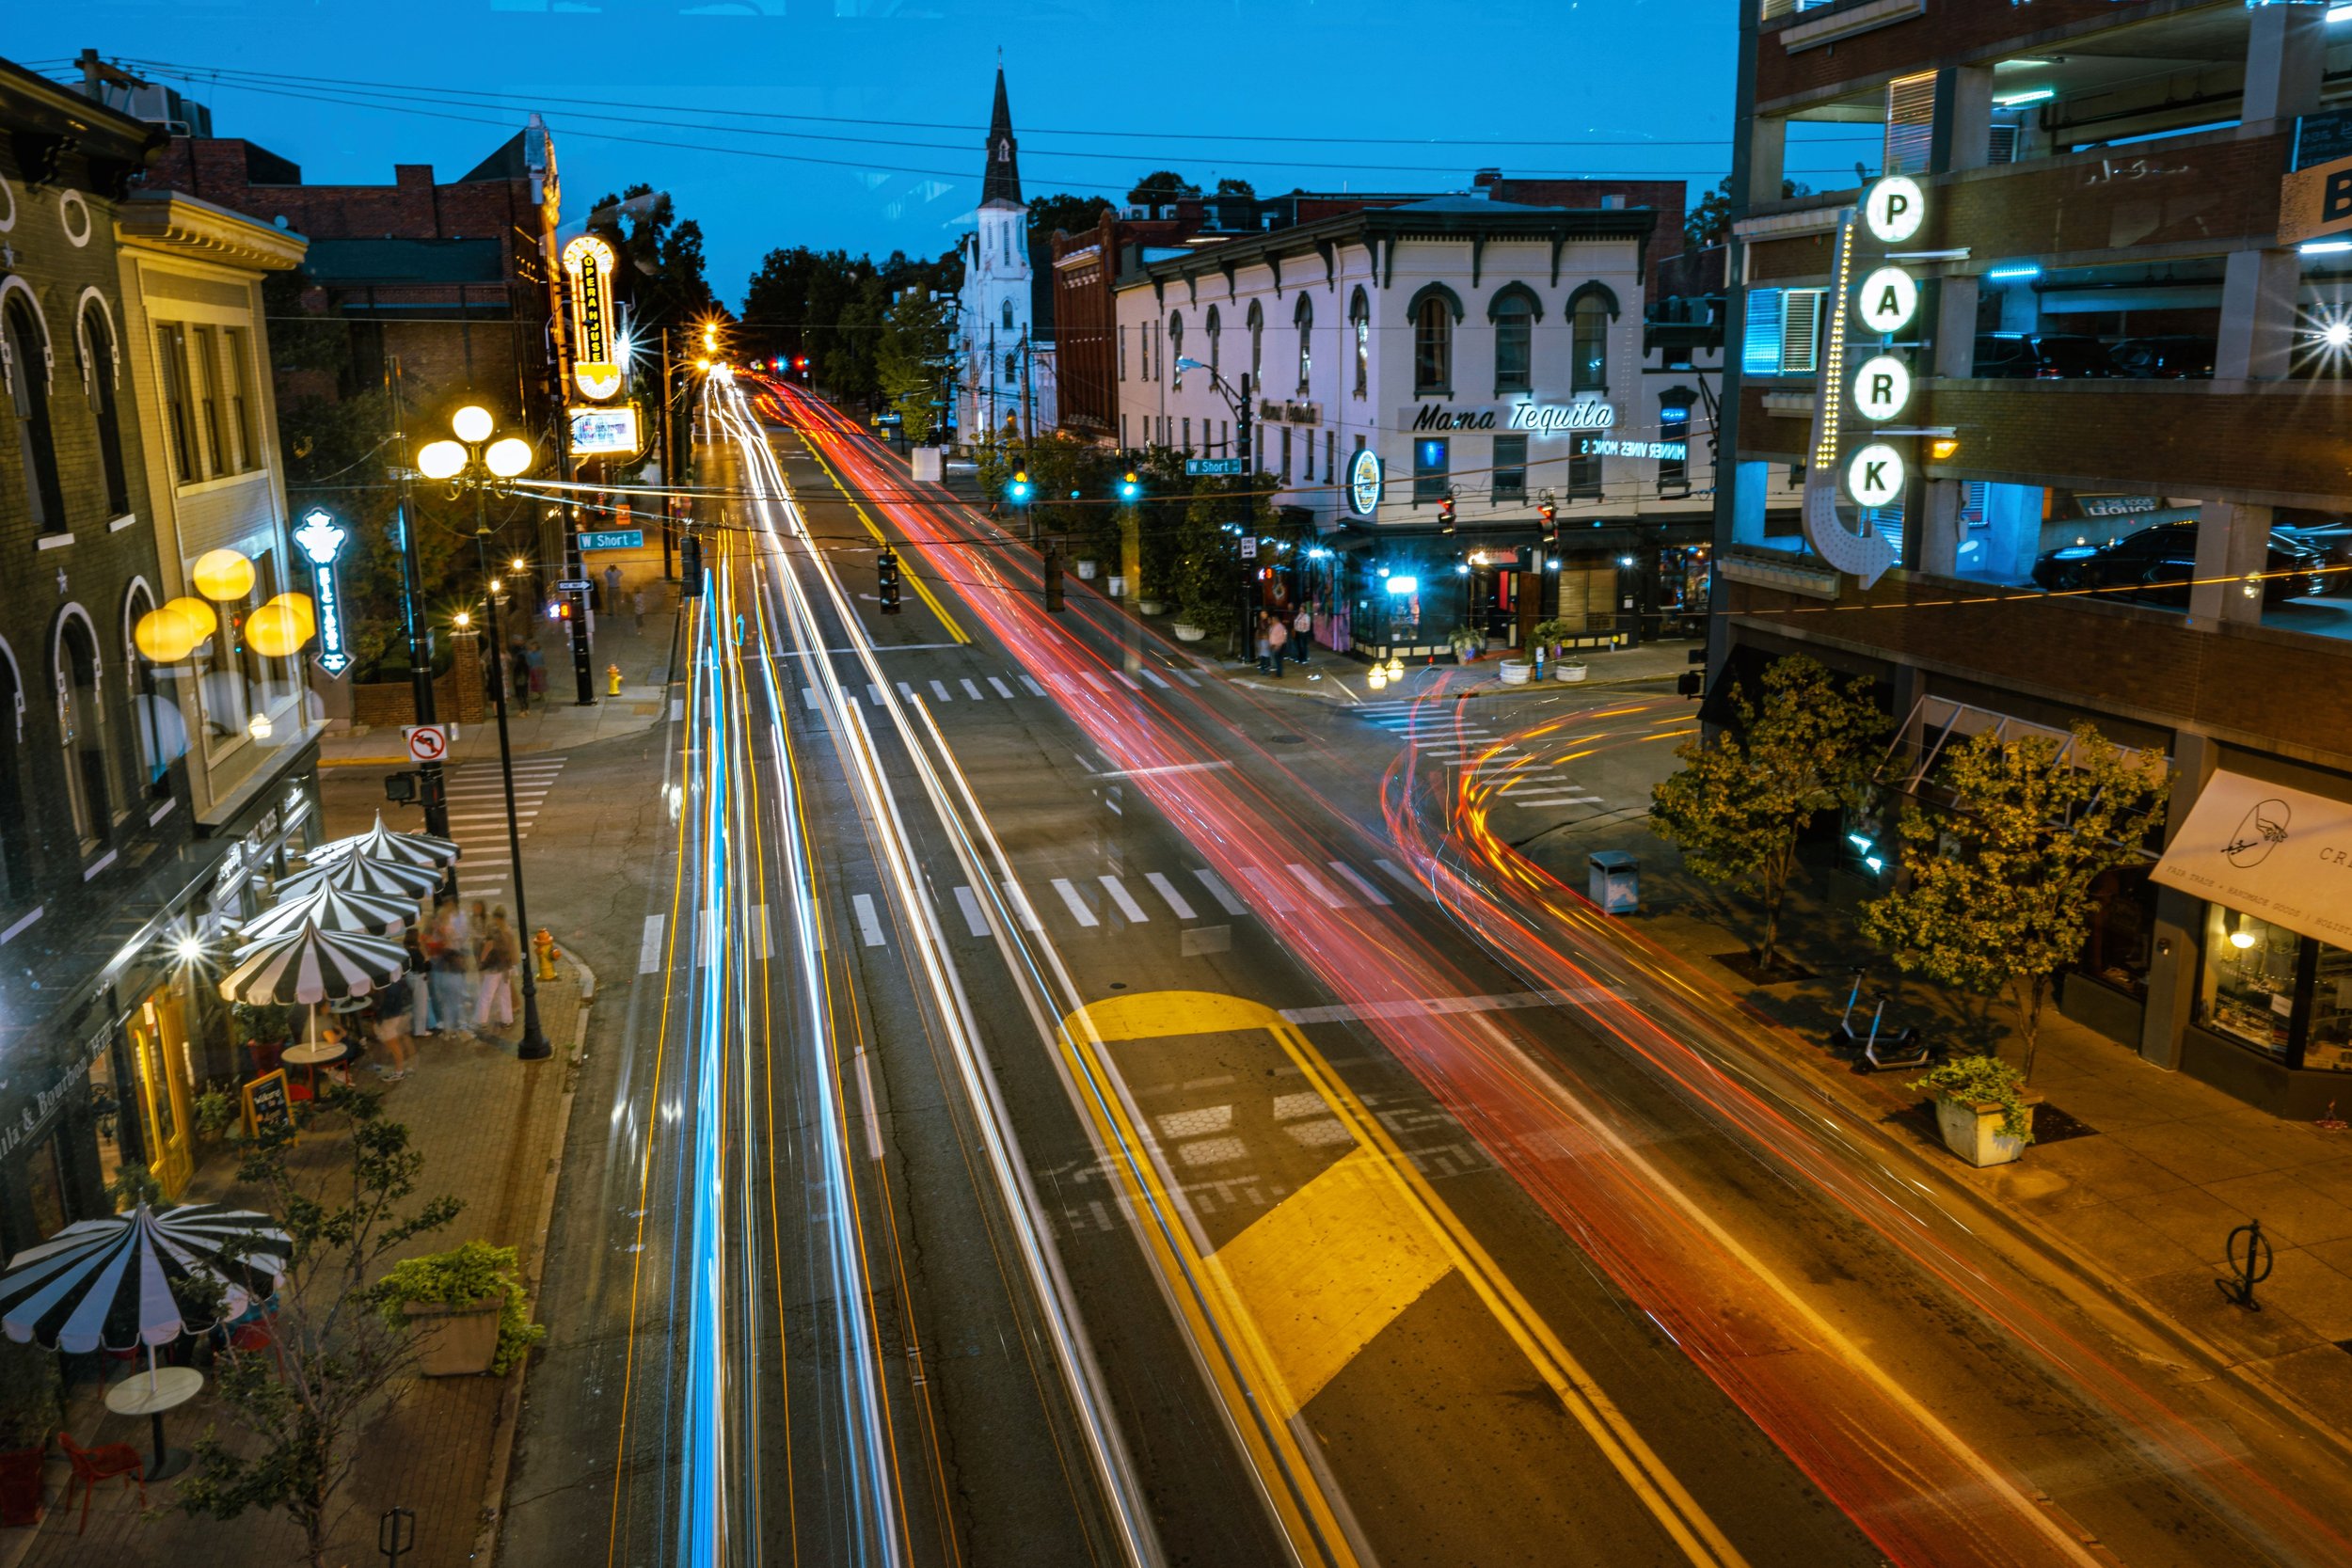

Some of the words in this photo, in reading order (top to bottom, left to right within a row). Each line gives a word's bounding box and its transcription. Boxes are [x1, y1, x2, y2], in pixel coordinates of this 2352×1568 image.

[583, 256, 597, 308] OPERA
[1864, 194, 1908, 492] PARK
[1412, 404, 1497, 431] Mama
[1512, 400, 1613, 436] Tequila
[1189, 461, 1198, 473] W
[1202, 461, 1229, 473] Short
[581, 535, 592, 547] W
[597, 533, 628, 547] Short
[2189, 874, 2216, 888] TRADE
[2227, 887, 2270, 907] HANDMADE
[2273, 903, 2301, 918] GOODS
[0, 1126, 21, 1160] ila
[37, 1055, 87, 1117] Bourbon
